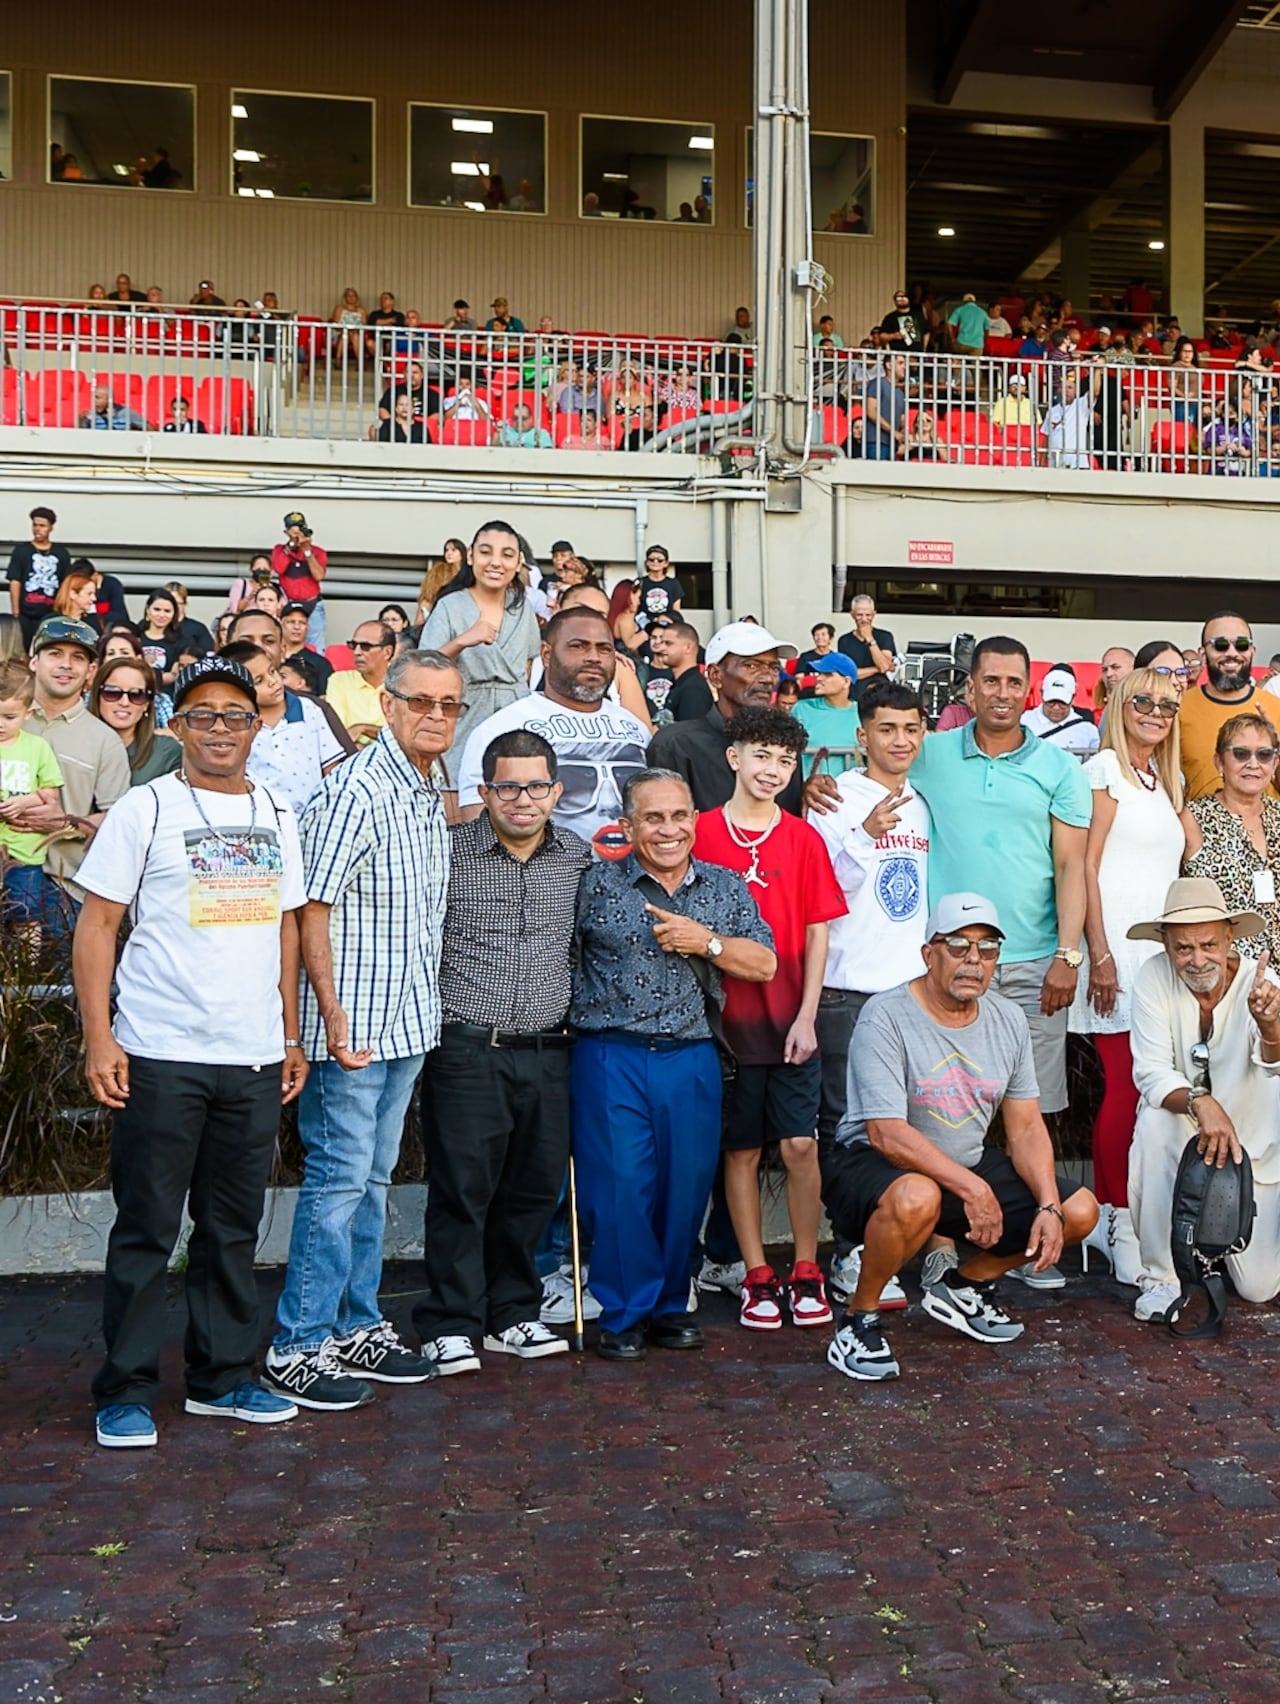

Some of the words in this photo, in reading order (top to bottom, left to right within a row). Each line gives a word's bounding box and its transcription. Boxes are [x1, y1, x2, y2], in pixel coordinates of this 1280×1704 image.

[523, 713, 645, 742] SOULS
[352, 1342, 388, 1369] N
[284, 1364, 319, 1393] N
